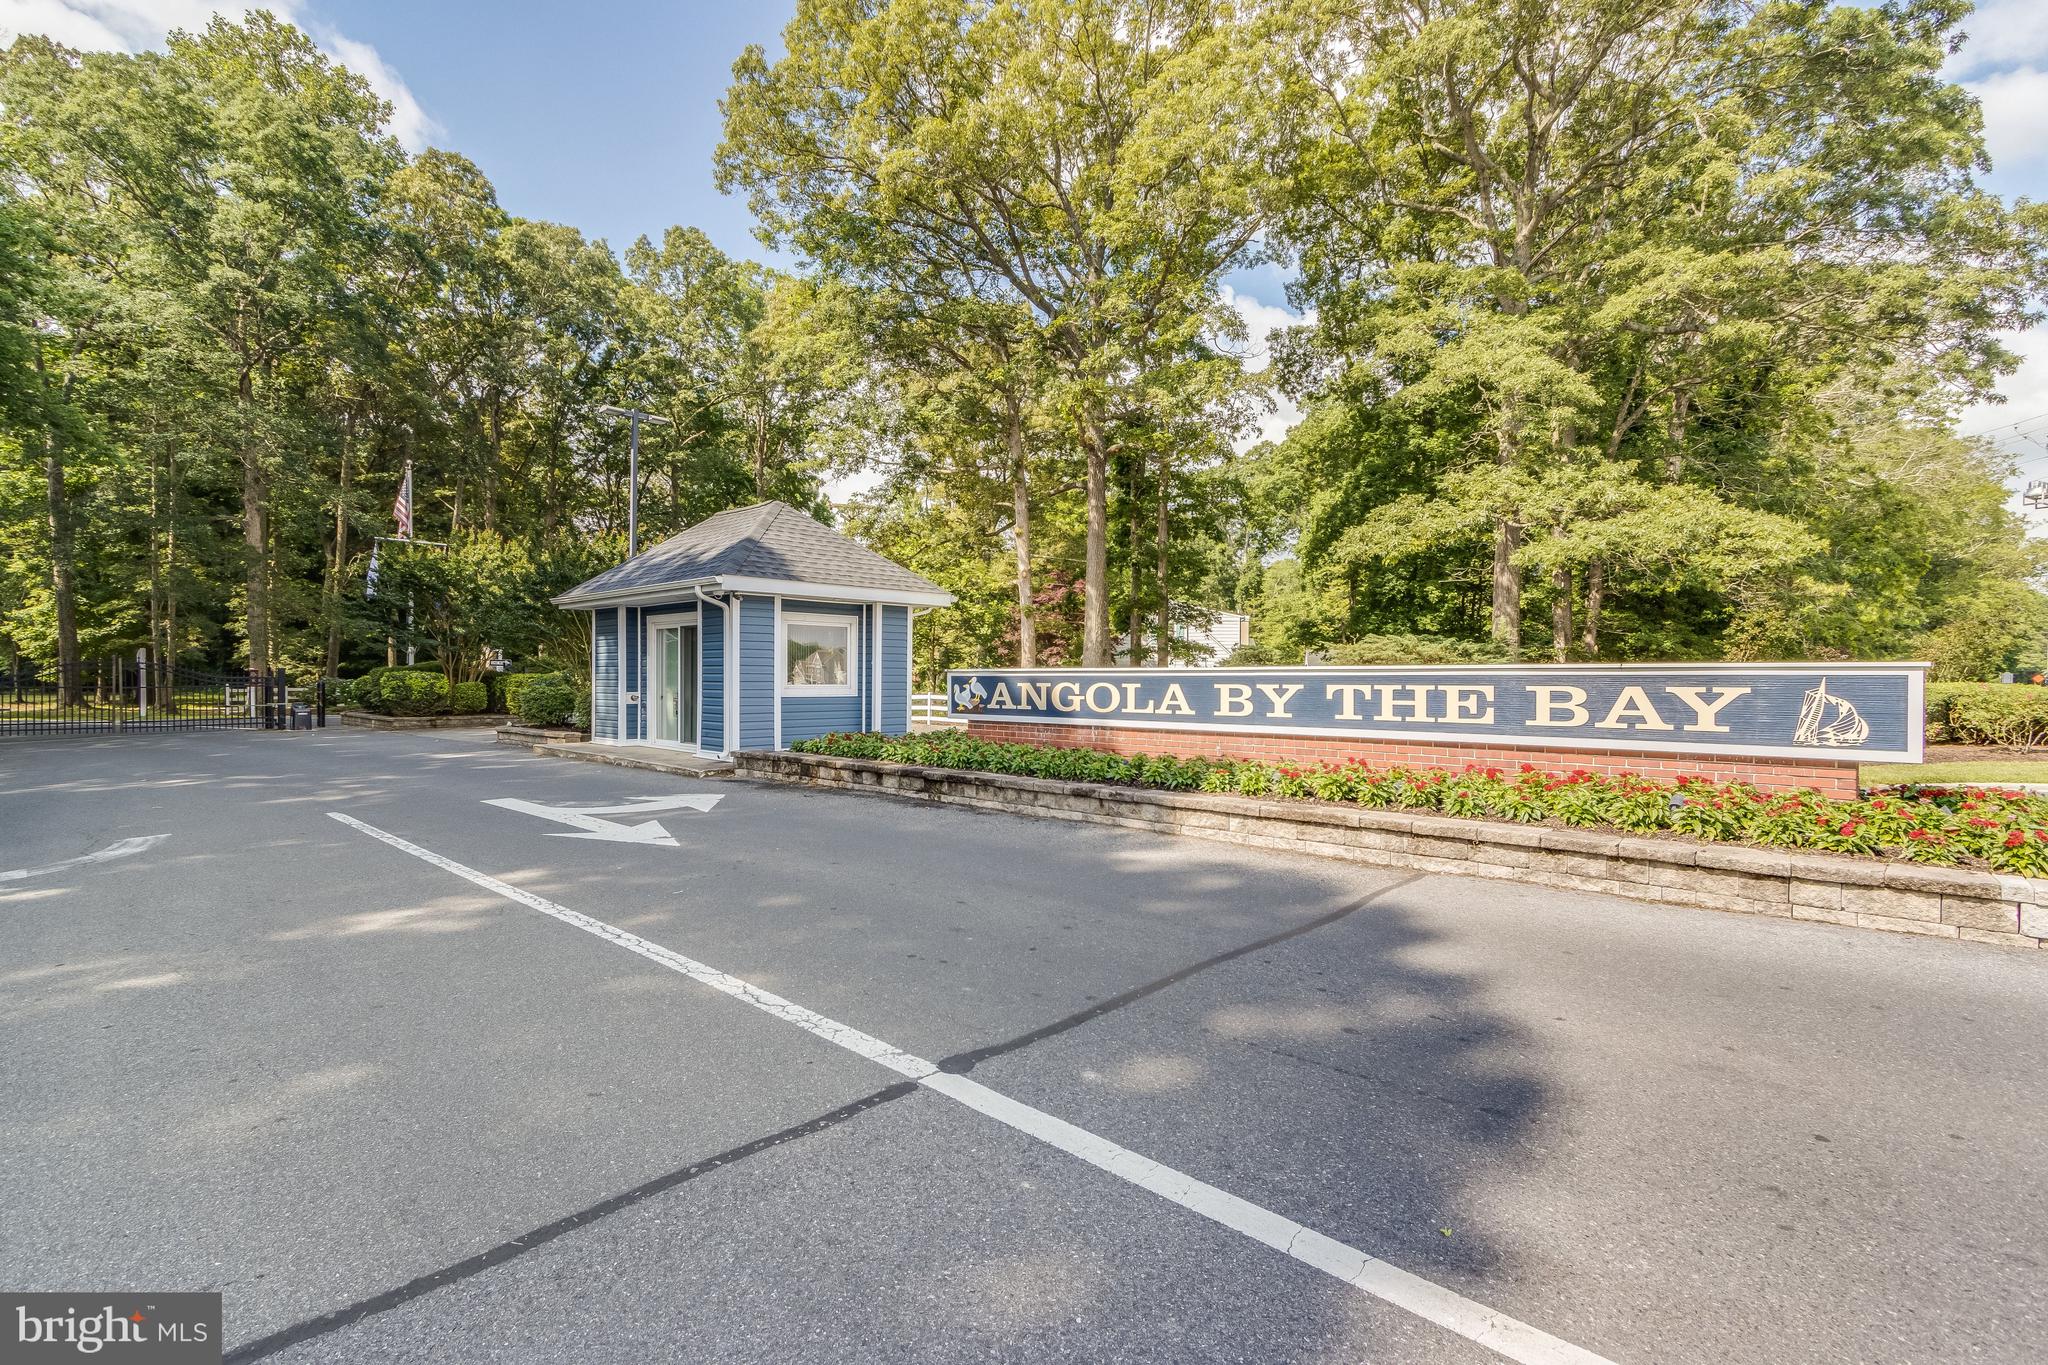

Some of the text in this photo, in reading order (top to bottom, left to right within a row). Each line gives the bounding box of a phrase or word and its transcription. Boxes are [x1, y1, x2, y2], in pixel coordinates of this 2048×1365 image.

[987, 682, 1752, 732] ANGOLA BY THE BAY
